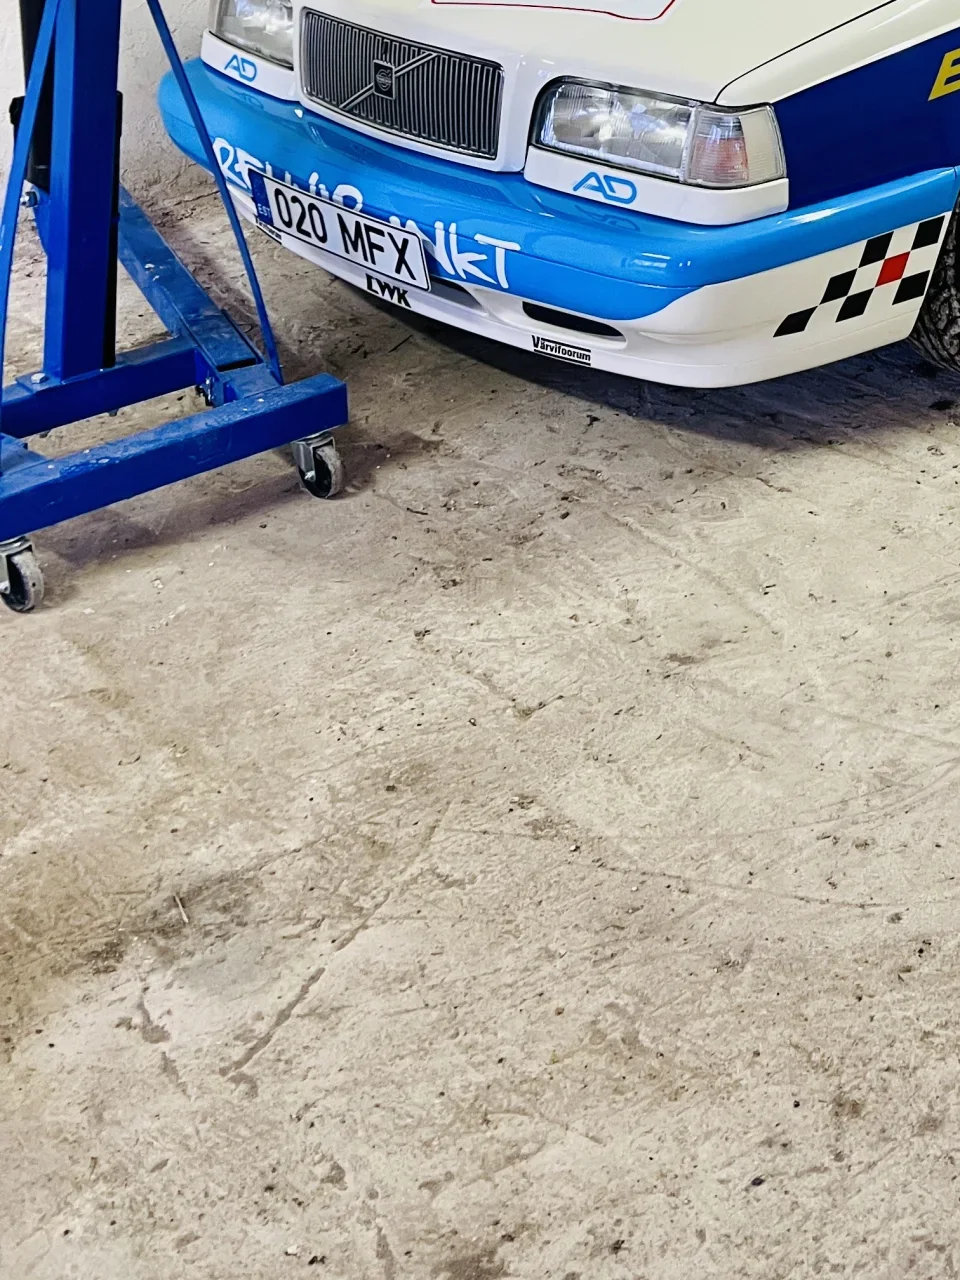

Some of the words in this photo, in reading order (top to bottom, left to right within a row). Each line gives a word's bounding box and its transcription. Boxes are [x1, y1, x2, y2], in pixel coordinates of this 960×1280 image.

[224, 54, 257, 82] AD
[573, 172, 637, 205] AD
[274, 187, 328, 244] 020
[337, 212, 417, 282] MFX
[532, 334, 591, 362] Värvifoorum
